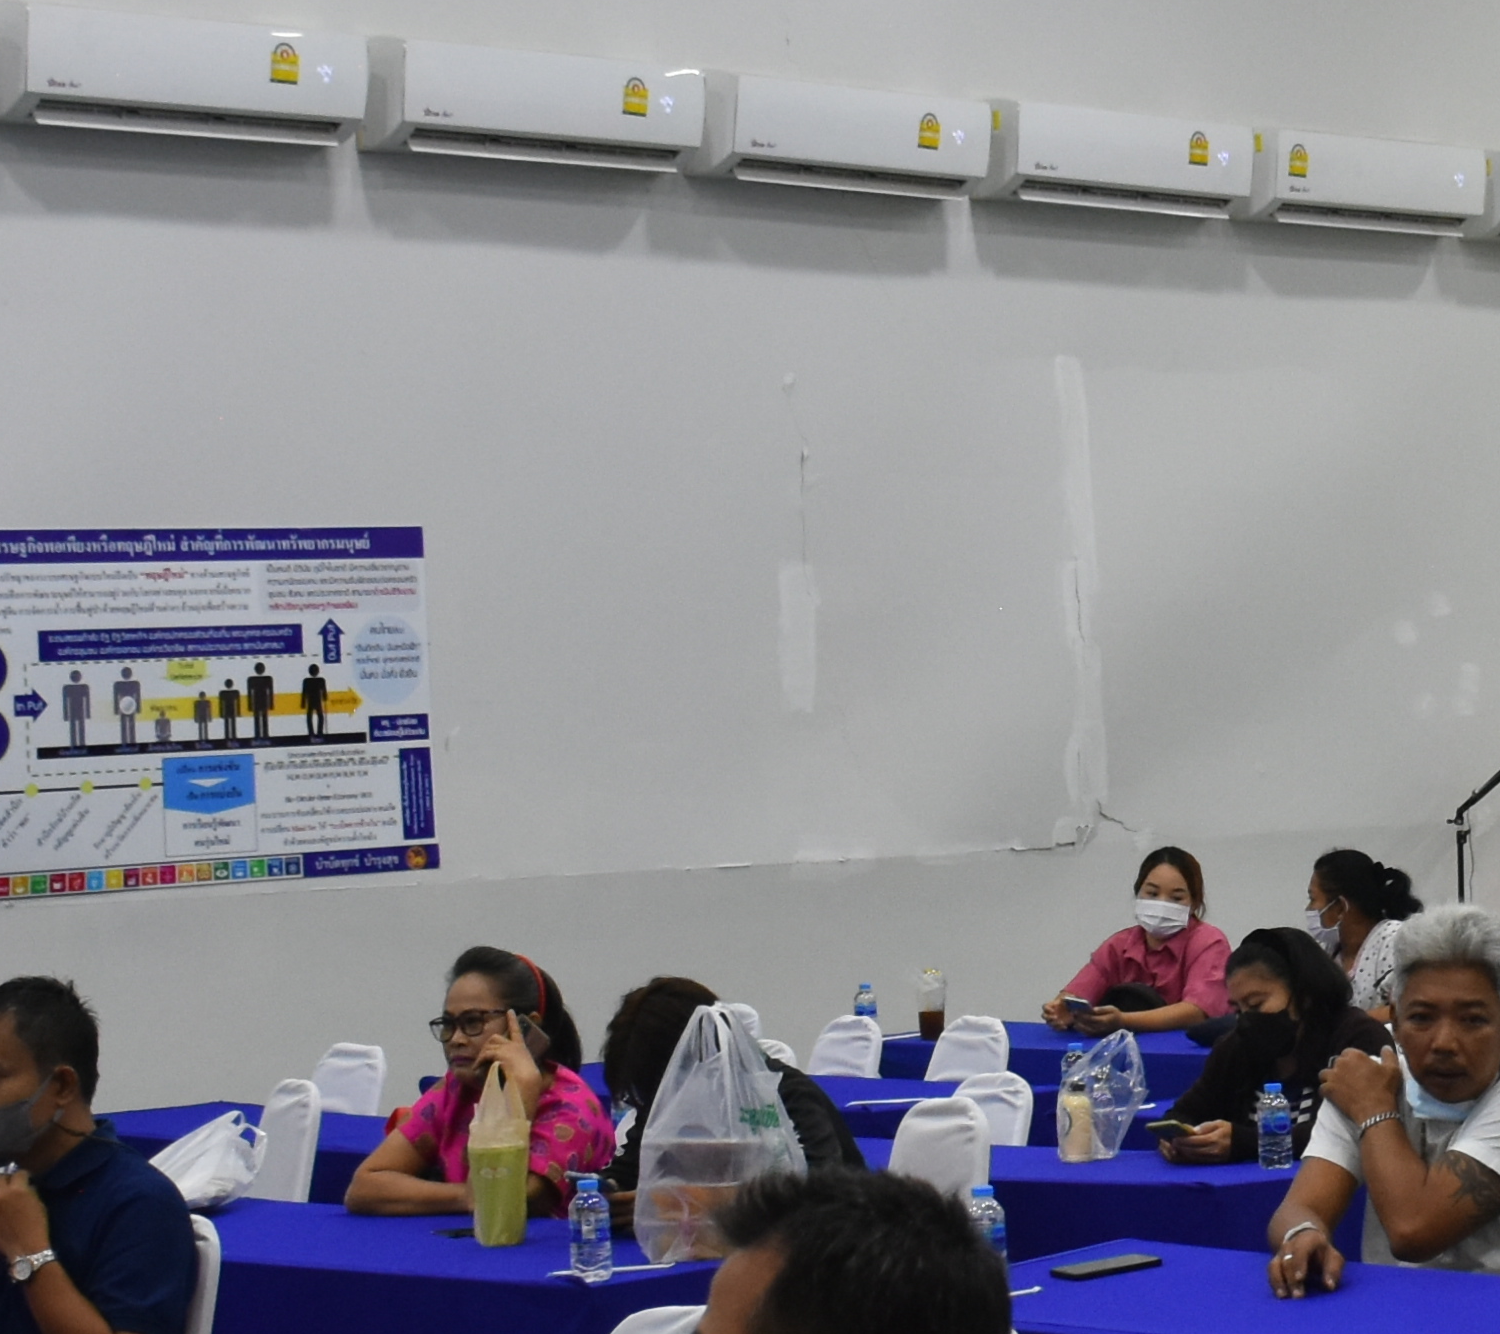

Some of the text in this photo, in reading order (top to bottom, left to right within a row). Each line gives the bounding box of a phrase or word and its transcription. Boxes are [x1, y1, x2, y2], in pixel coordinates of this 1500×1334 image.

[315, 852, 400, 871] บำบัดทุกข์ บำรุงสุข
